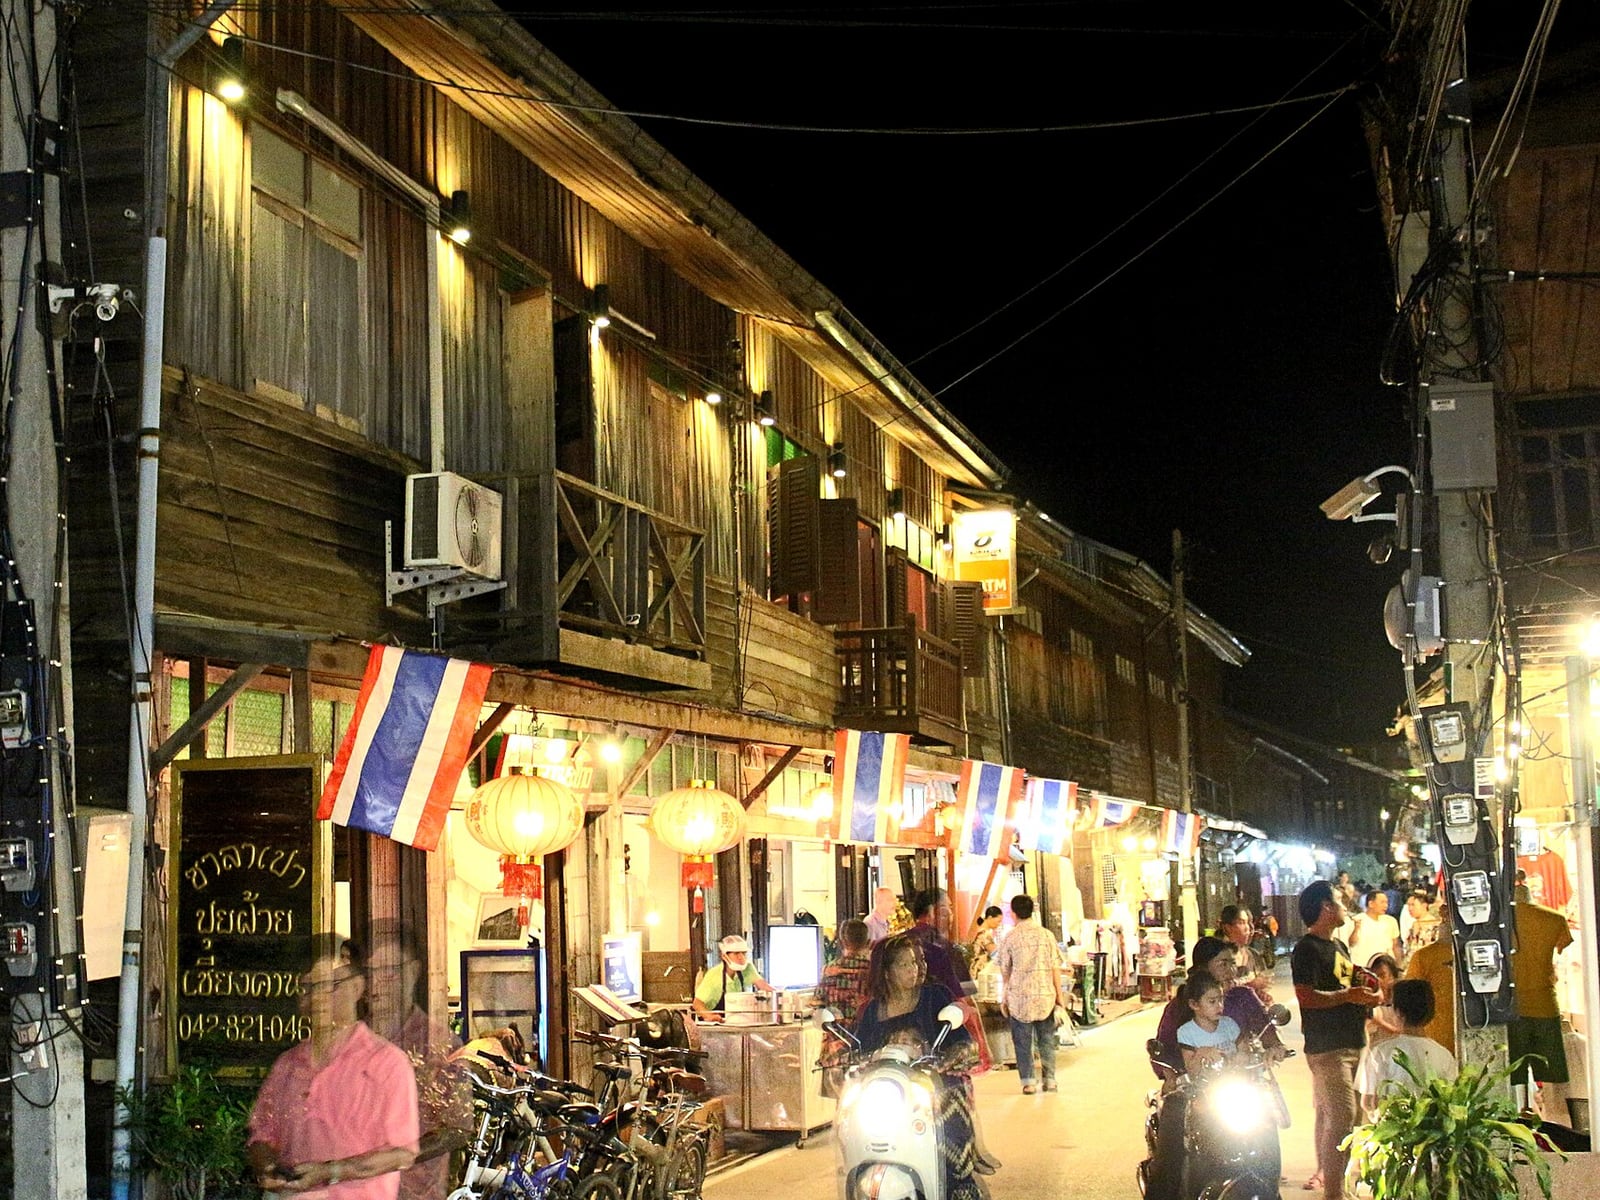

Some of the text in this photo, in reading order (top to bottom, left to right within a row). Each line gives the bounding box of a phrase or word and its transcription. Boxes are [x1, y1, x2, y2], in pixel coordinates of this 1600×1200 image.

[185, 842, 306, 890] ซาลาเปา
[179, 1013, 312, 1042] 042-821-046
